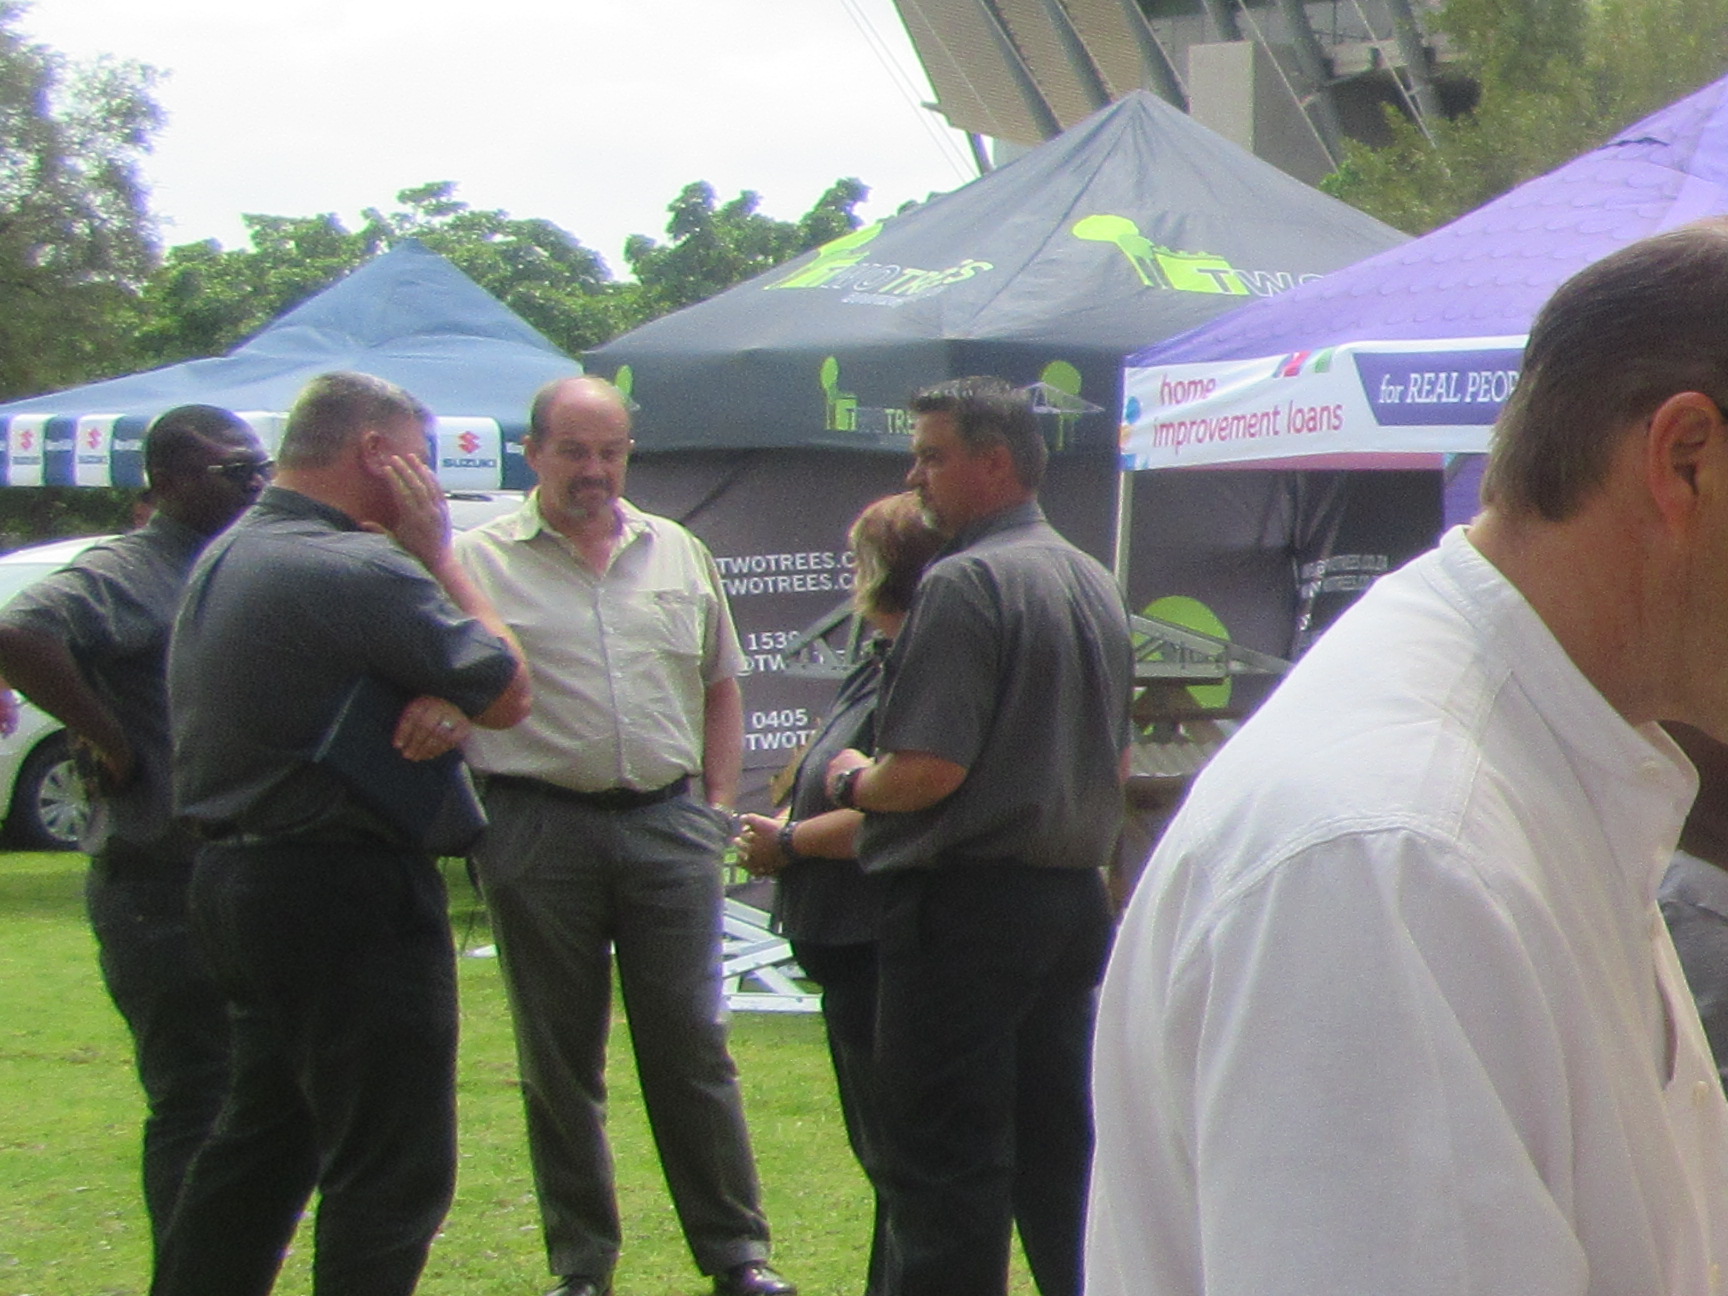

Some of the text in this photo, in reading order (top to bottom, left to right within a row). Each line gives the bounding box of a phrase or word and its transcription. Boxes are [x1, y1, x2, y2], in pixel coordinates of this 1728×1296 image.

[1378, 378, 1406, 404] for
[1406, 371, 1461, 403] REAL
[1152, 401, 1344, 456] improvement loans
[752, 708, 808, 729] 0405
